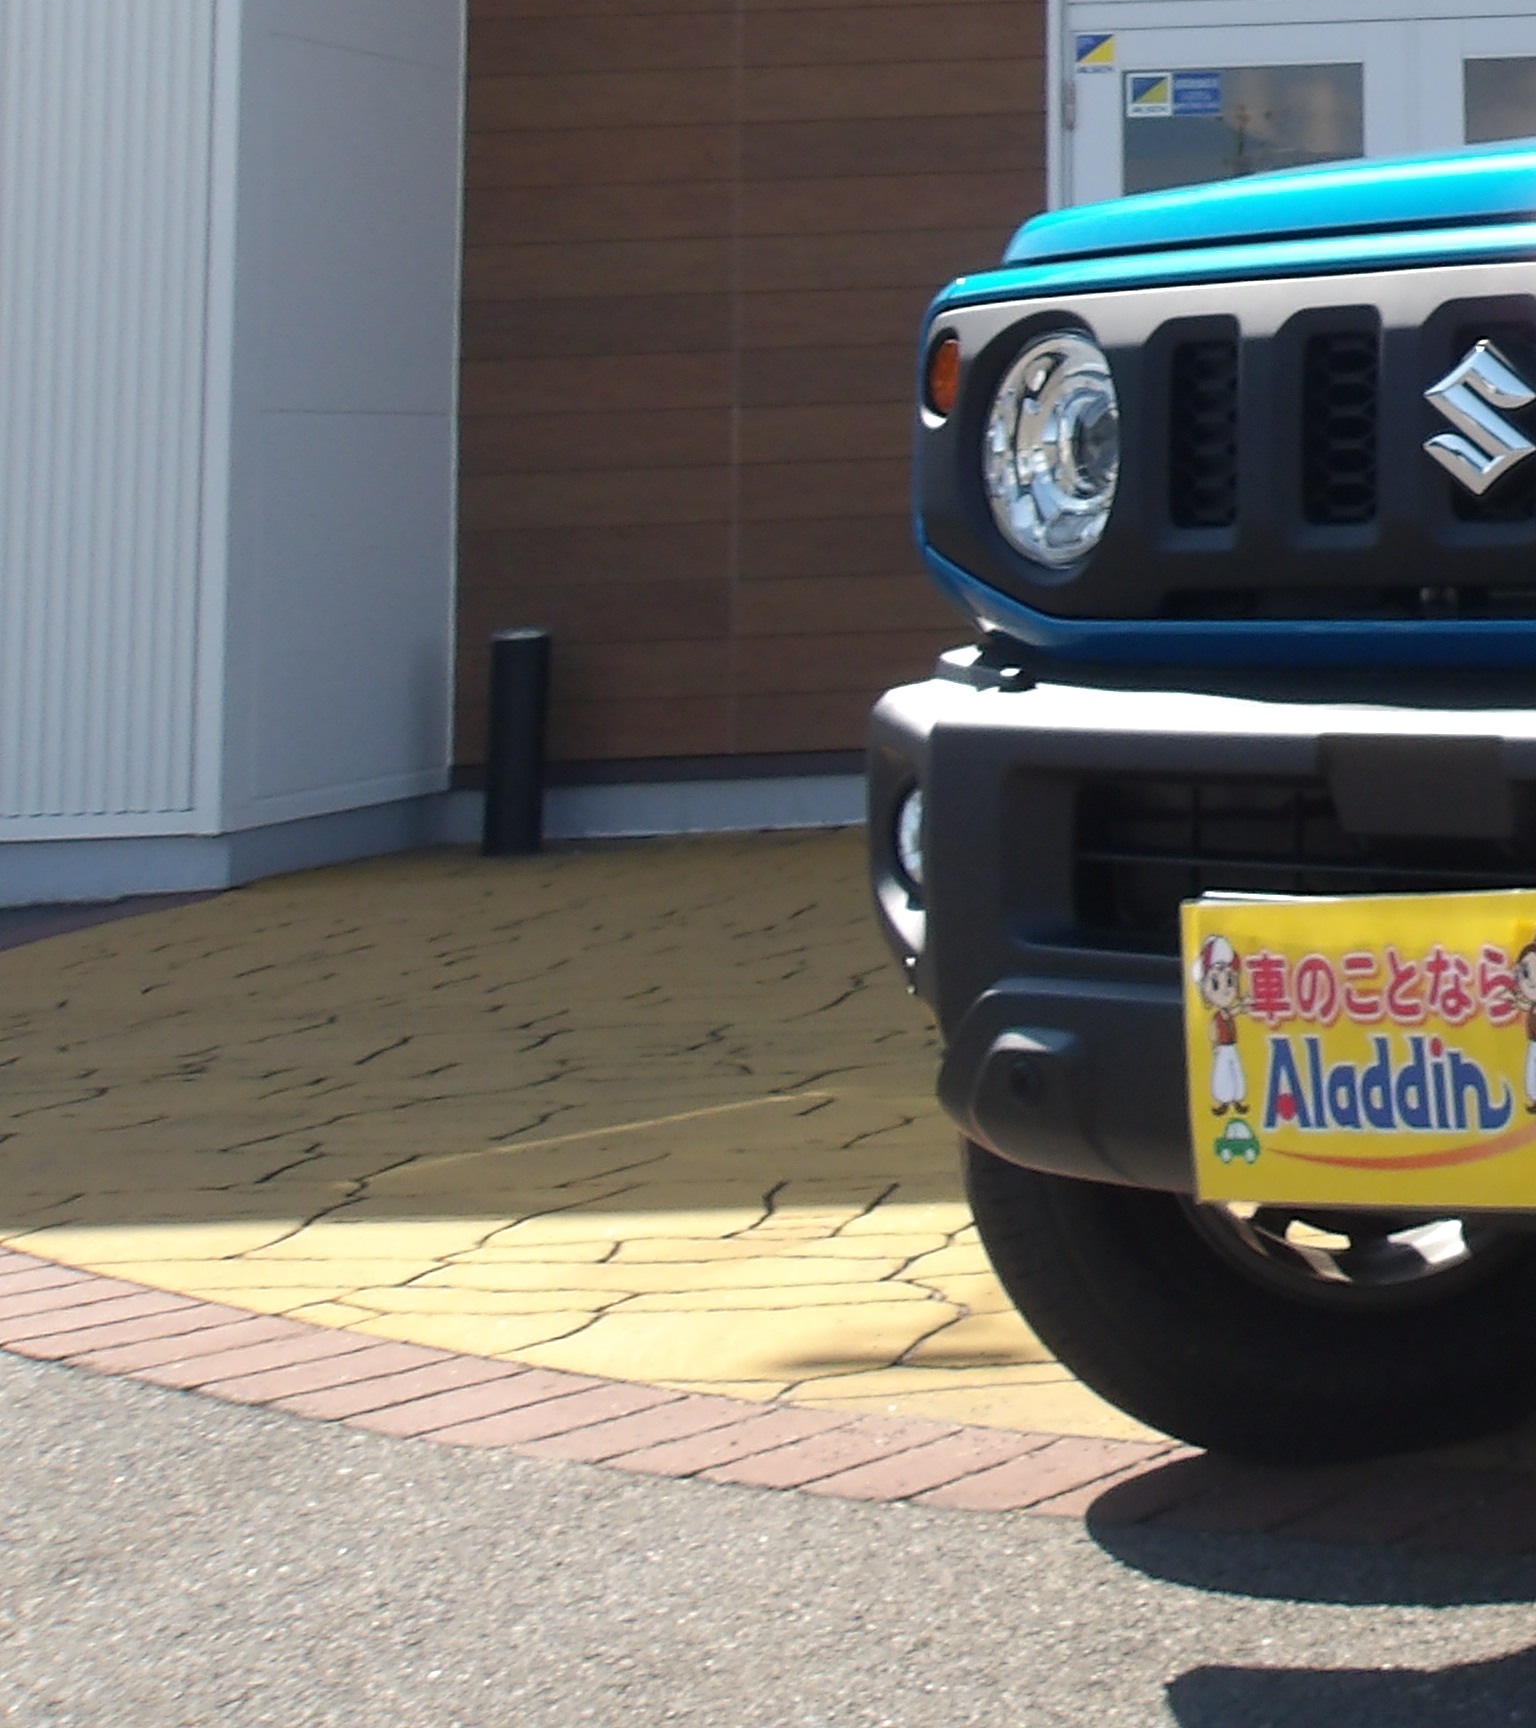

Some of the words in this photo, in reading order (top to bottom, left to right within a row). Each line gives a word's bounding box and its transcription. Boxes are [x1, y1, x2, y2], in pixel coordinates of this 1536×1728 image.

[1244, 947, 1520, 1024] 車のことなら
[1263, 1036, 1512, 1130] Aladdin
